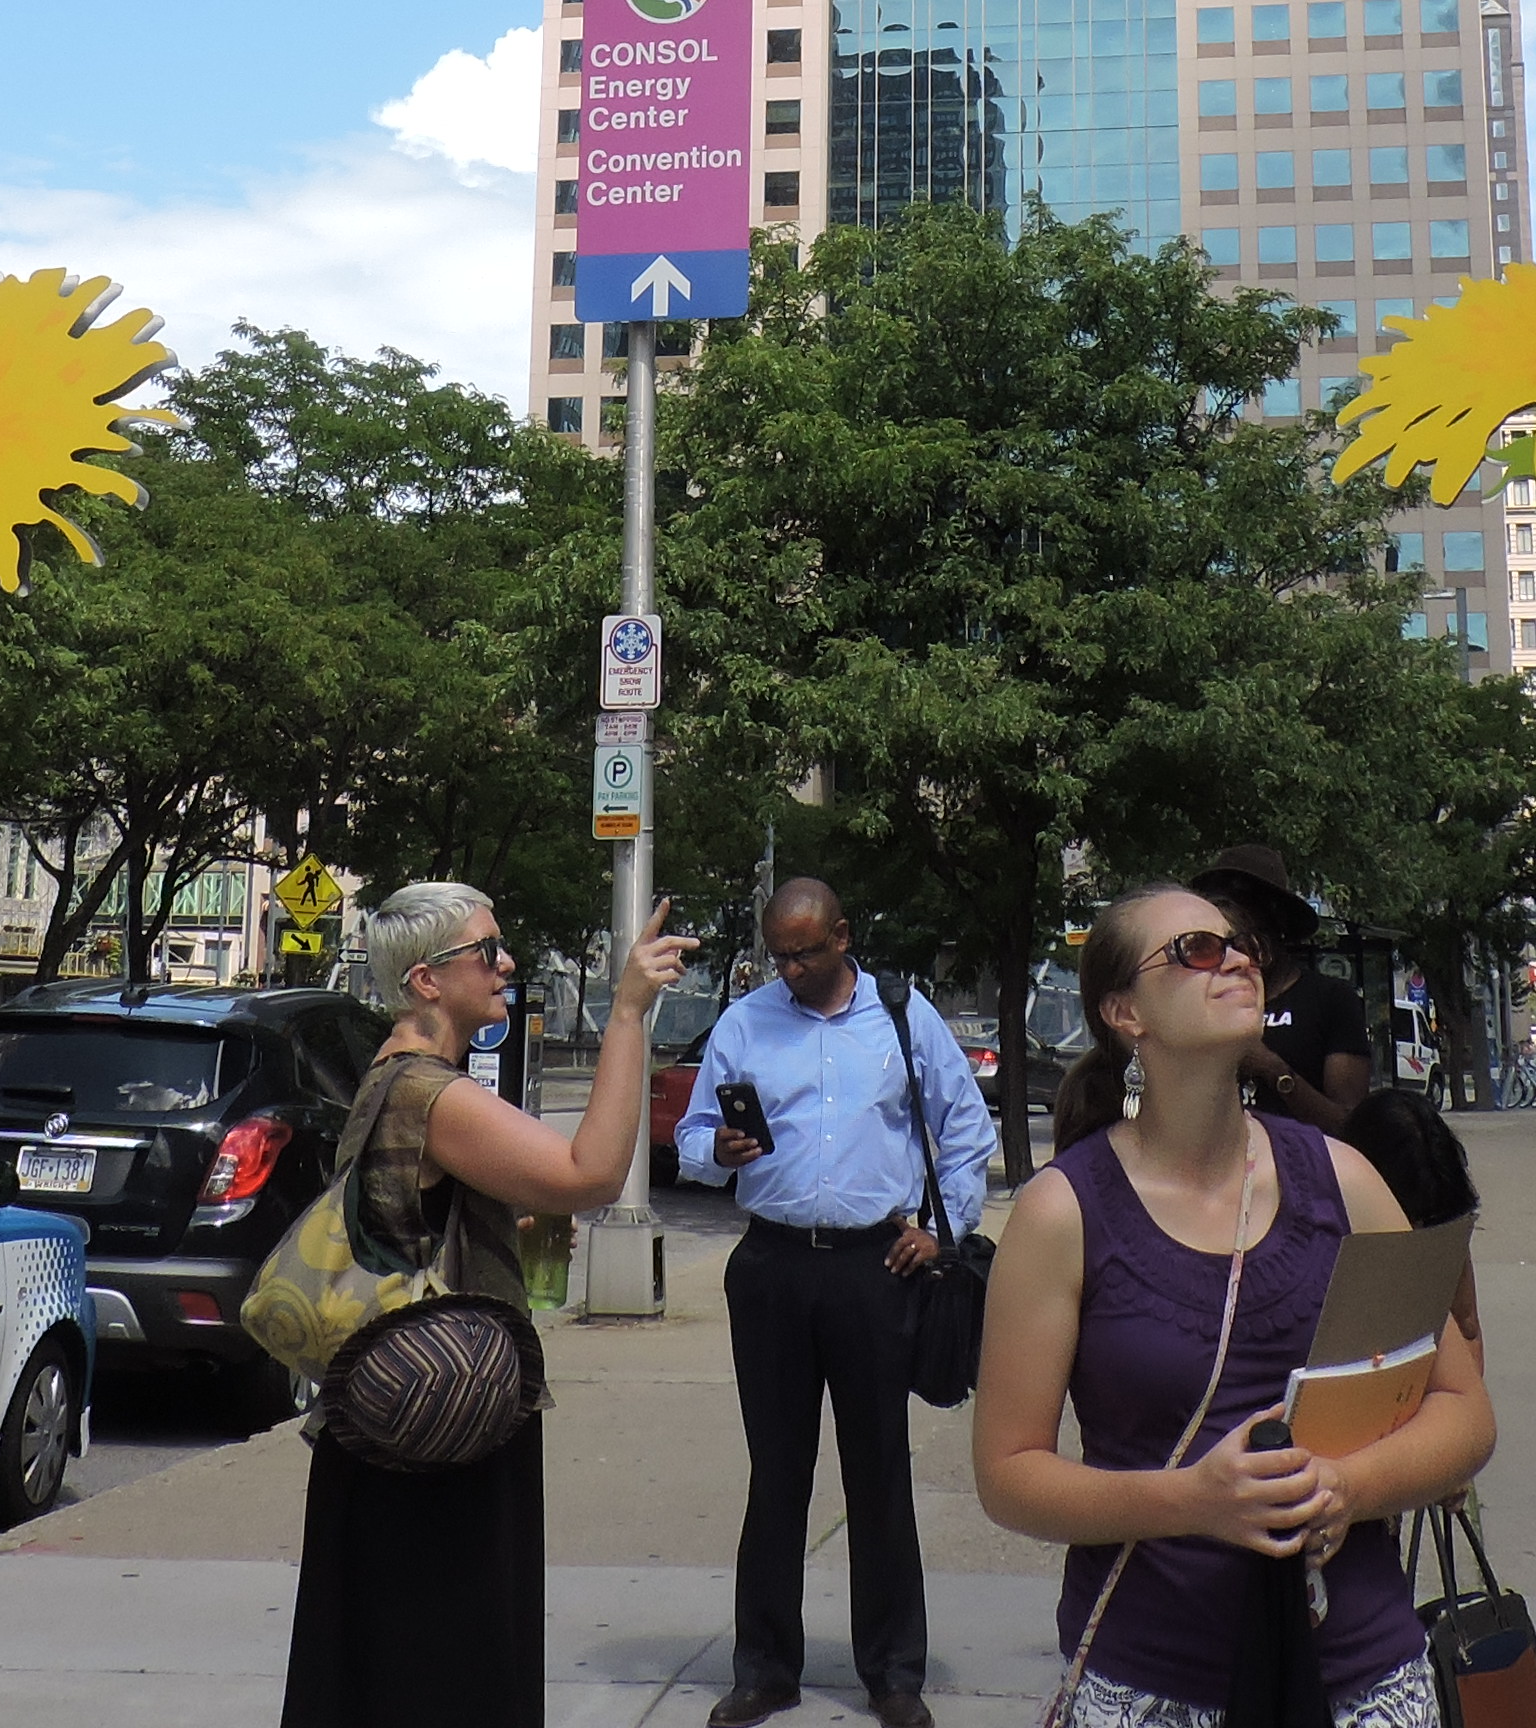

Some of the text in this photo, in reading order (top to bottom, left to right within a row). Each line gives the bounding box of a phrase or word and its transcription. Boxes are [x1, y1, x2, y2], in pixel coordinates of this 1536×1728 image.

[590, 38, 719, 68] CONSOL
[588, 75, 692, 101] Energy
[588, 105, 689, 132] Center
[587, 145, 743, 174] Convention
[585, 181, 684, 207] Center
[608, 666, 653, 676] EMERGENCY
